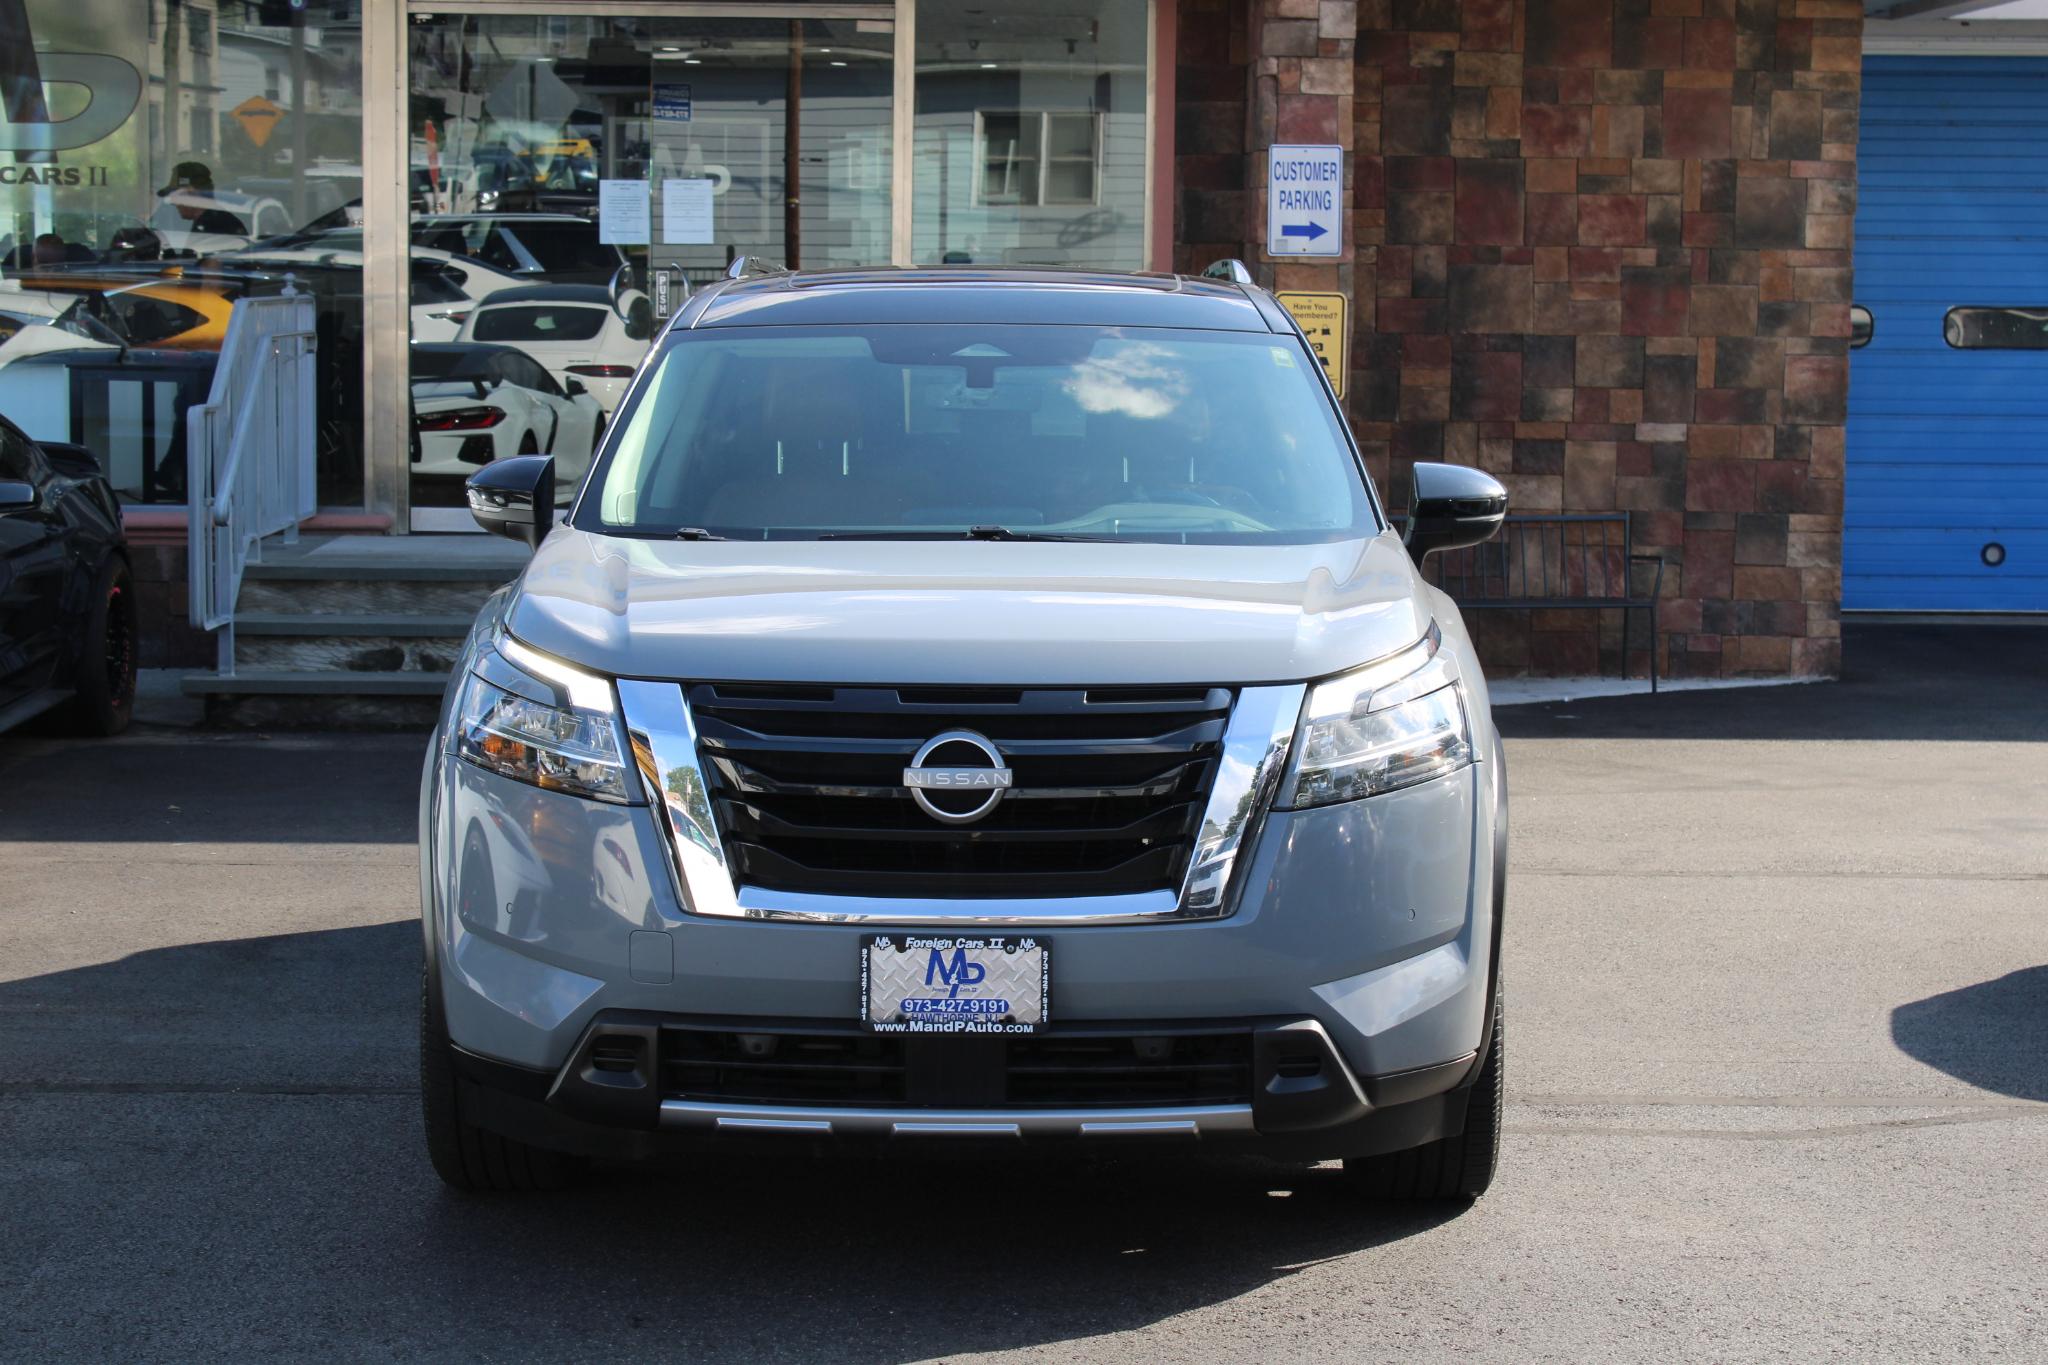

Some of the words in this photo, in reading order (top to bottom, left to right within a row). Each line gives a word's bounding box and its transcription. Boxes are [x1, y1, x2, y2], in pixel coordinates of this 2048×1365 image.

[0, 166, 81, 186] CARS
[88, 166, 108, 186] II
[1273, 161, 1337, 181] CUSTOMER
[1279, 190, 1332, 210] PARKING
[659, 276, 667, 314] PUSH
[1314, 303, 1328, 311] You
[1293, 312, 1338, 320] membered?
[906, 771, 1009, 785] NISSAN
[905, 936, 953, 951] Foreign
[955, 937, 985, 949] Cars
[988, 938, 1005, 949] II
[903, 999, 1006, 1013] 973-427-9191
